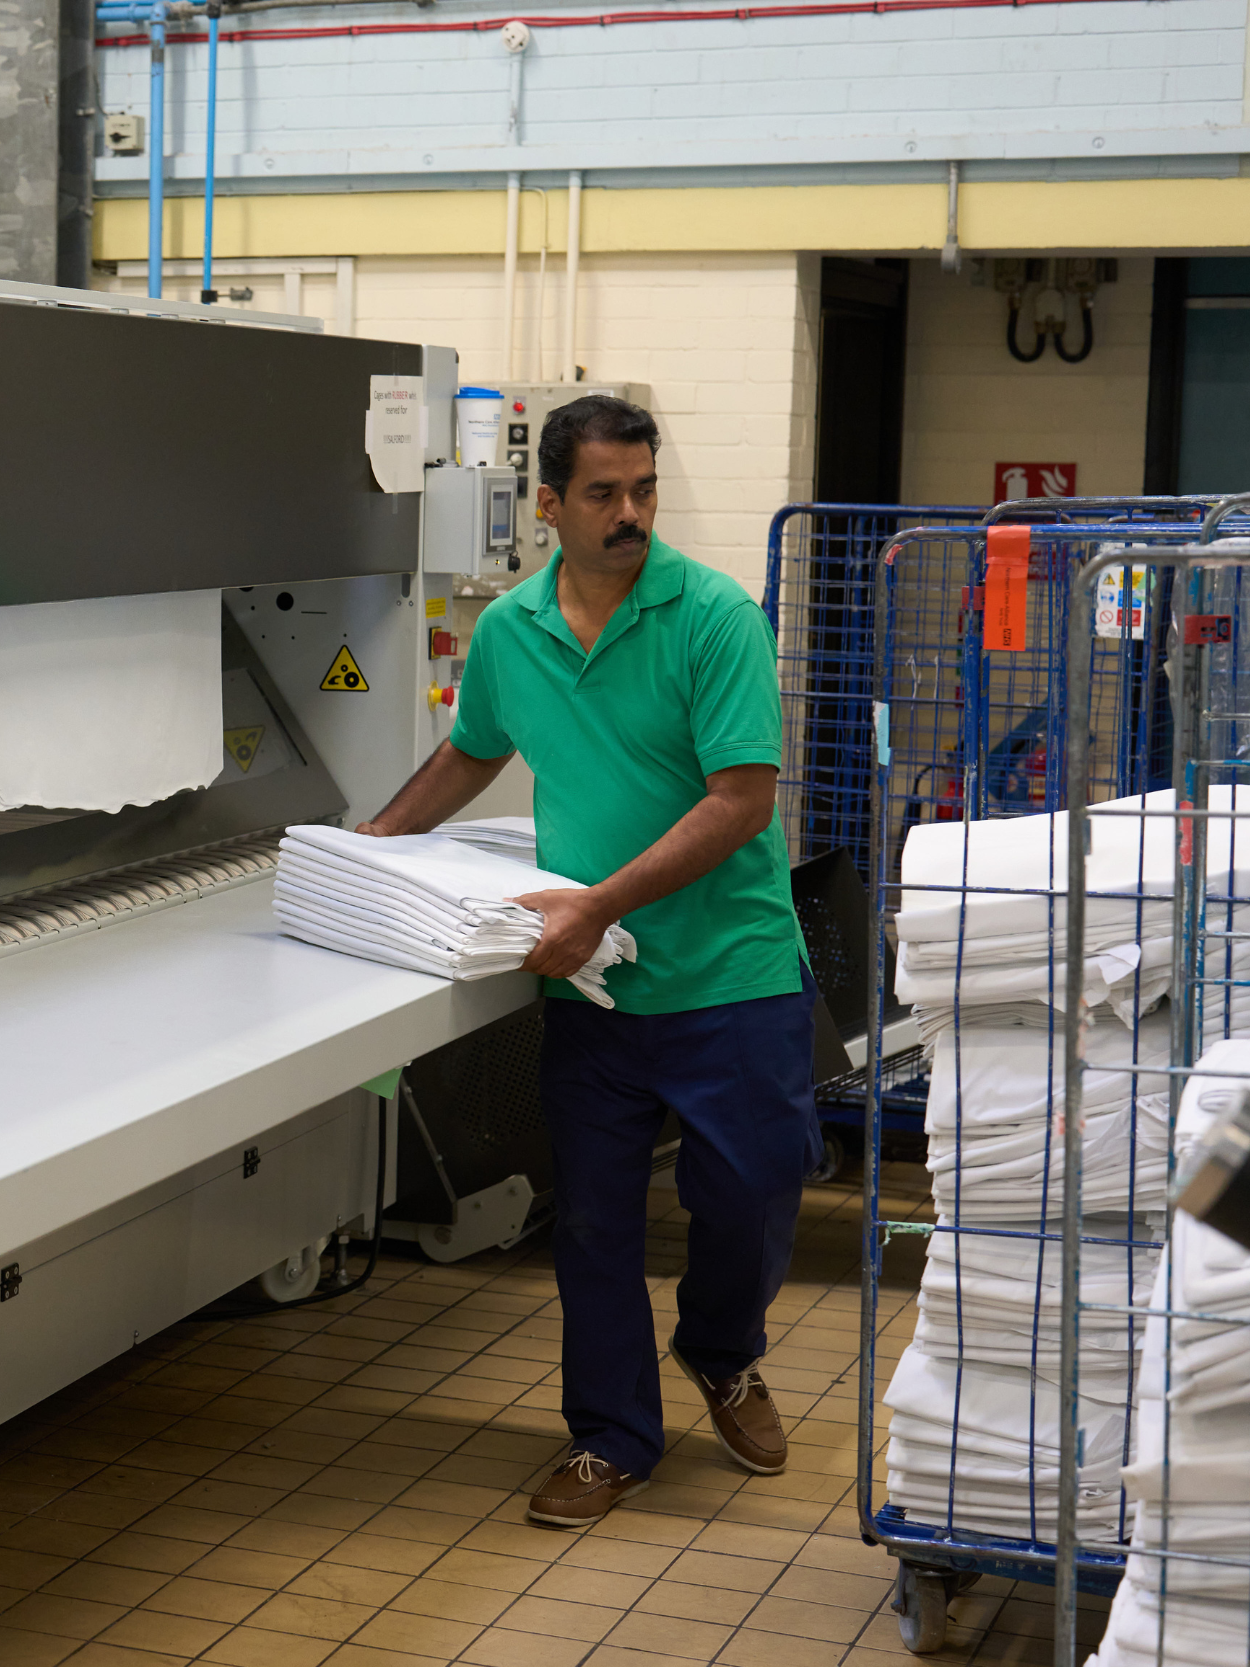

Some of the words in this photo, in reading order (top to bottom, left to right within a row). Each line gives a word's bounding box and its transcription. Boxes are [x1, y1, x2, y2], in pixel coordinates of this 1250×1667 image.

[392, 390, 408, 399] RUBBER
[400, 405, 408, 414] for
[1003, 629, 1011, 646] NHS
